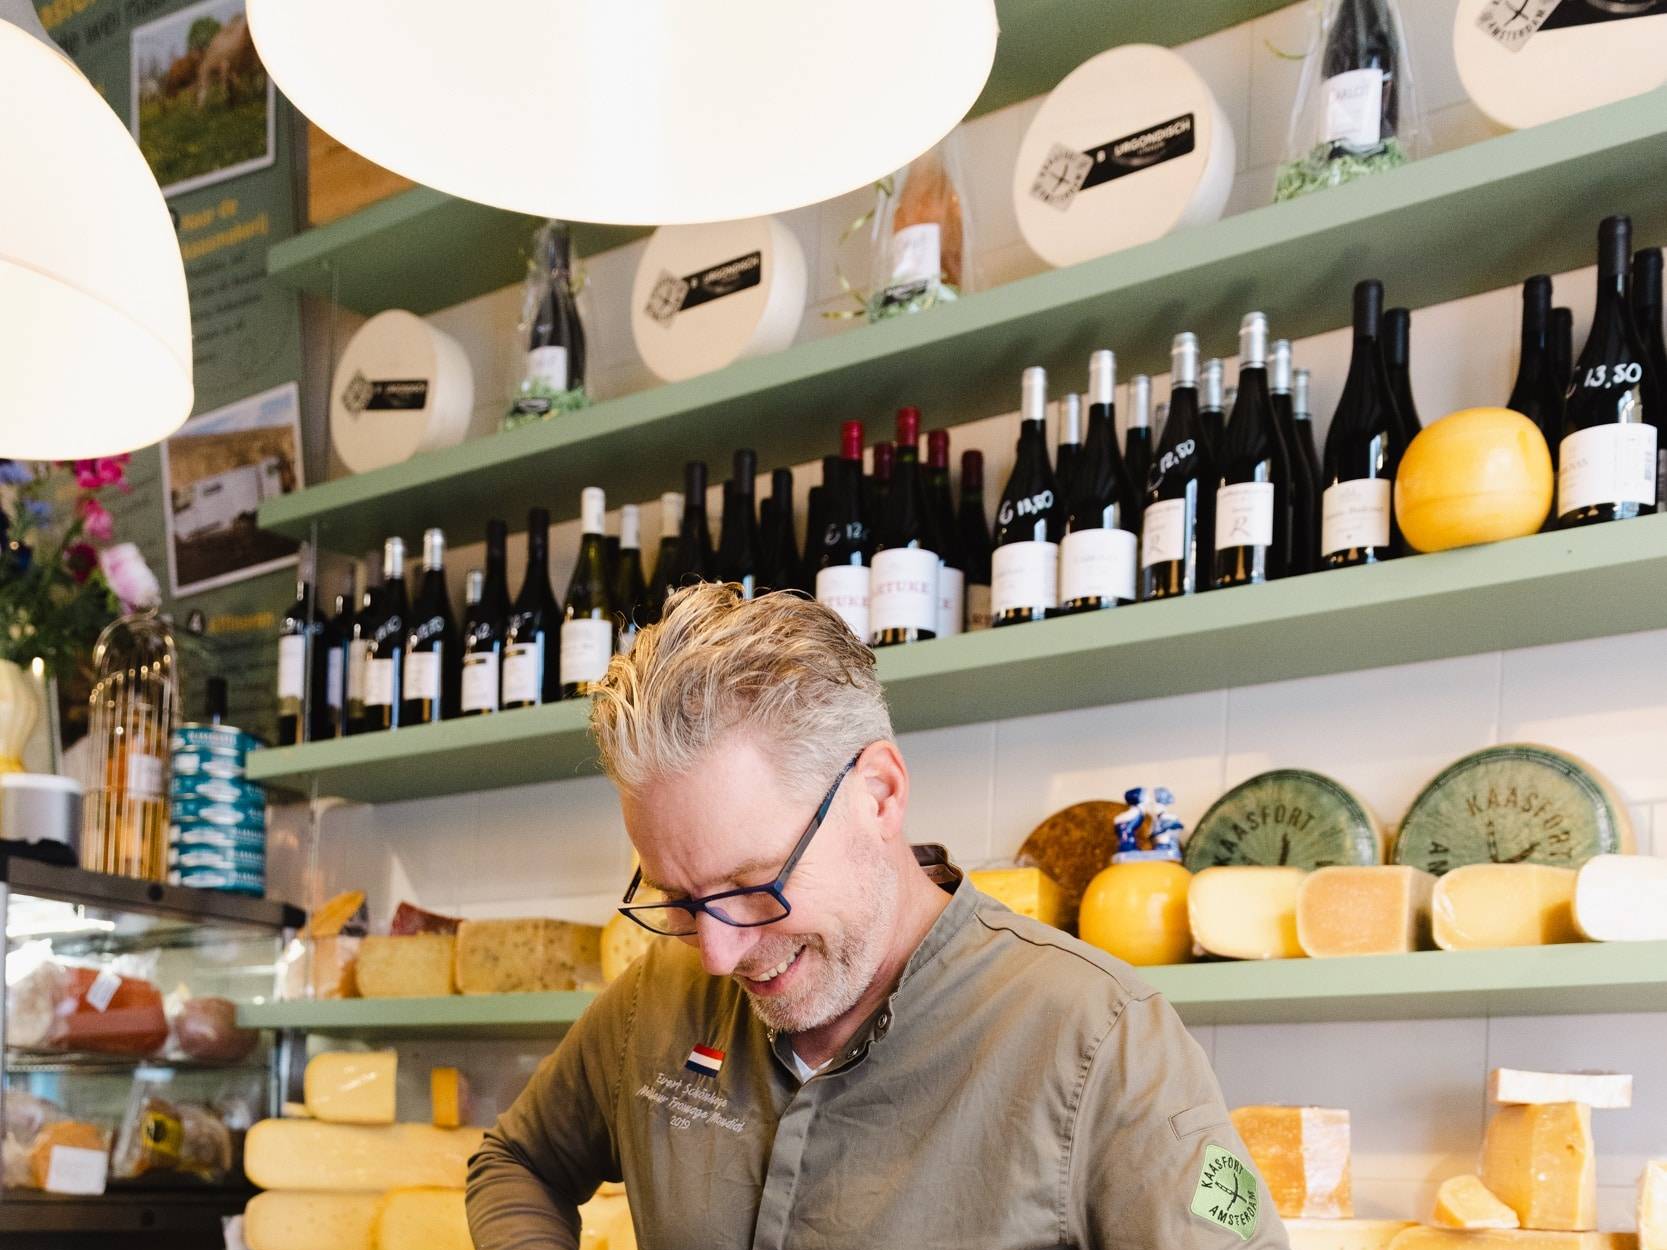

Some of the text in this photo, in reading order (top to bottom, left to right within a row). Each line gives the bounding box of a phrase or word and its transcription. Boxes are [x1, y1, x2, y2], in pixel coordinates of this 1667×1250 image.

[1213, 803, 1316, 866] KAASFORT
[1466, 783, 1575, 860] KAASFORT
[669, 1115, 691, 1130] 2019
[1201, 1156, 1244, 1189] KAASFORT
[1208, 1190, 1257, 1226] AMSTERDAM
